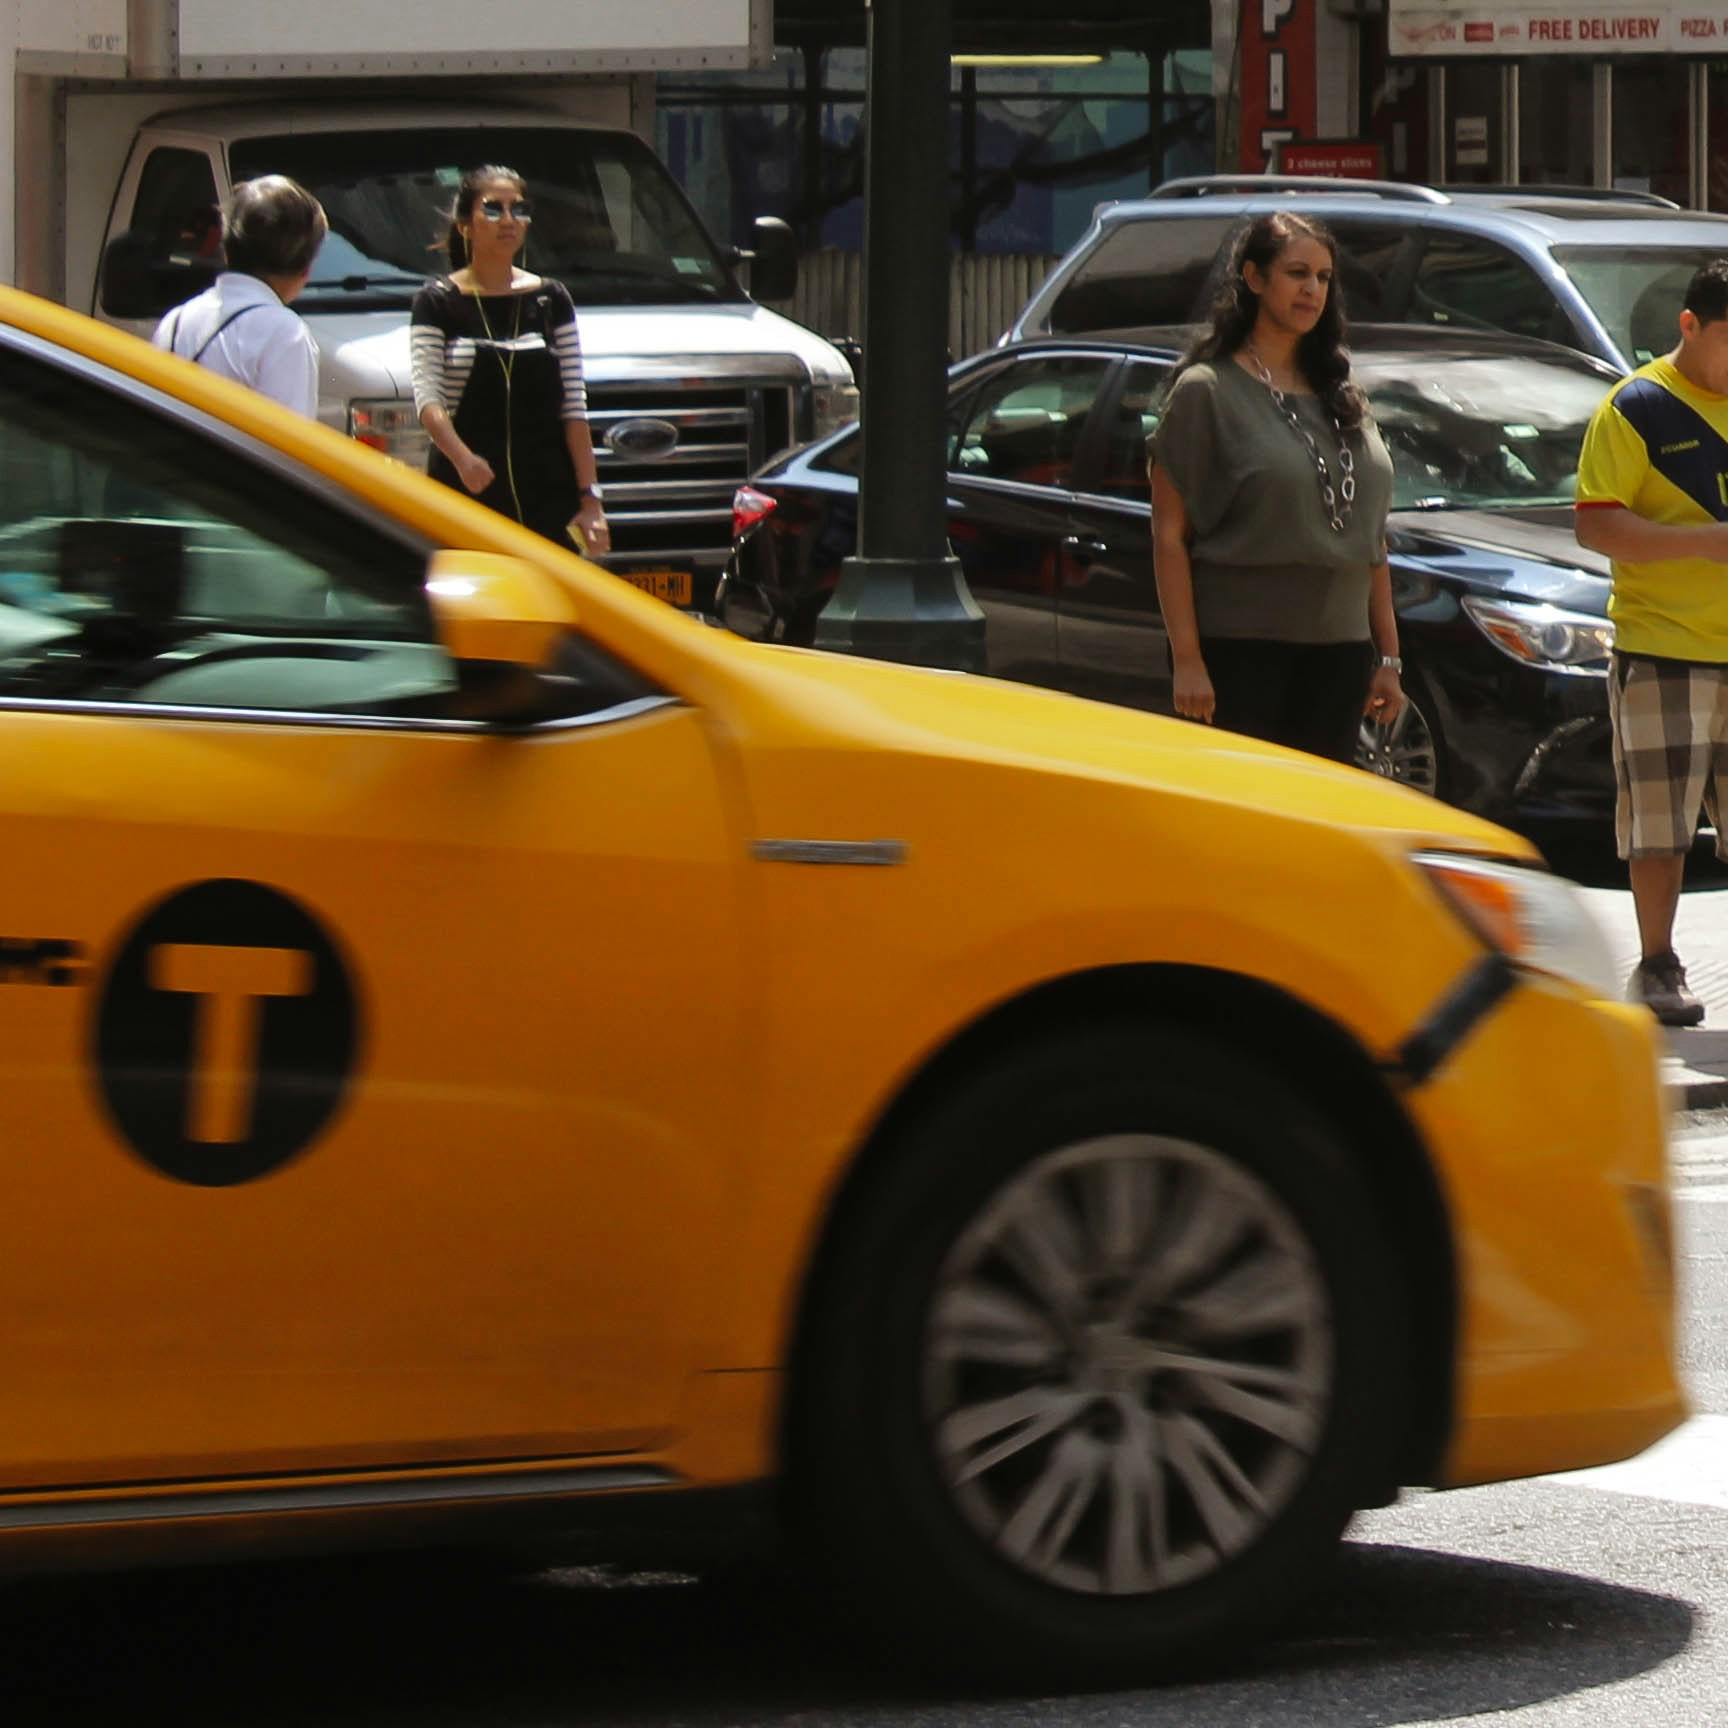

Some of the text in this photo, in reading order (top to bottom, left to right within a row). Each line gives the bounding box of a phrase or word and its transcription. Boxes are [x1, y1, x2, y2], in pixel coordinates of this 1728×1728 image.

[1528, 17, 1661, 41] FREE DELIVERY
[1680, 17, 1717, 39] PIZZA
[147, 943, 318, 1143] T
